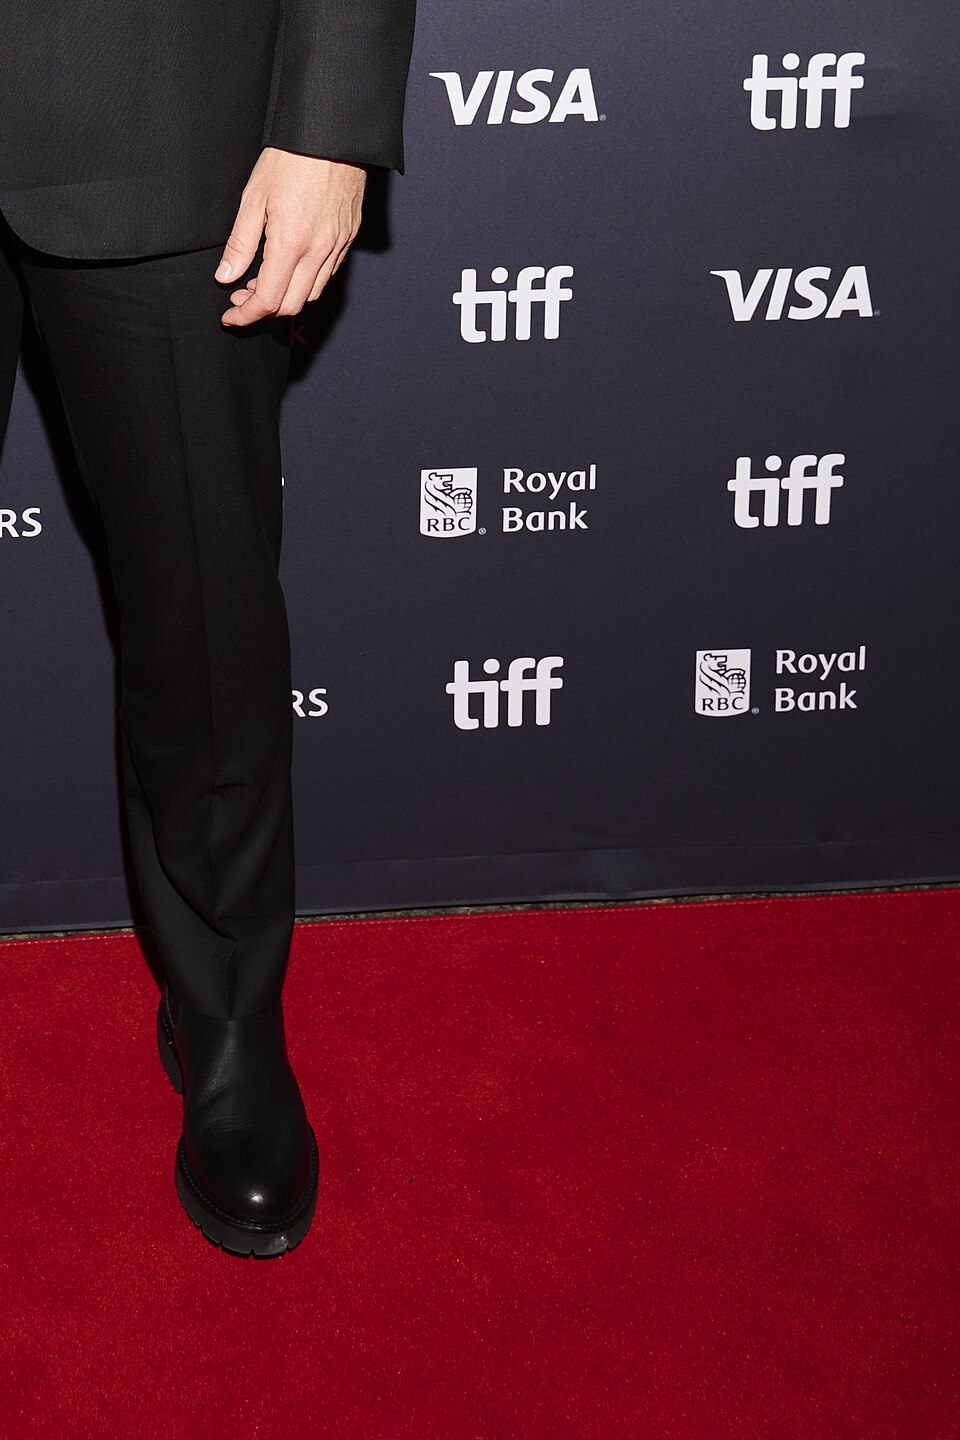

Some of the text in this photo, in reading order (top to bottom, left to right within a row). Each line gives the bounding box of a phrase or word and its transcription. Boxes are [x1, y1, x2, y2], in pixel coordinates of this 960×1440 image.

[429, 69, 598, 125] VISA
[744, 53, 865, 130] tiff
[453, 266, 573, 342] tiff
[710, 266, 872, 321] VISA
[504, 465, 596, 500] Royal
[728, 454, 844, 528] tiff
[427, 517, 469, 532] RBC
[503, 502, 588, 532] Bank
[777, 646, 865, 680] Royal
[446, 657, 563, 729] tiff
[702, 697, 743, 711] RBC
[775, 683, 857, 711] Bank
